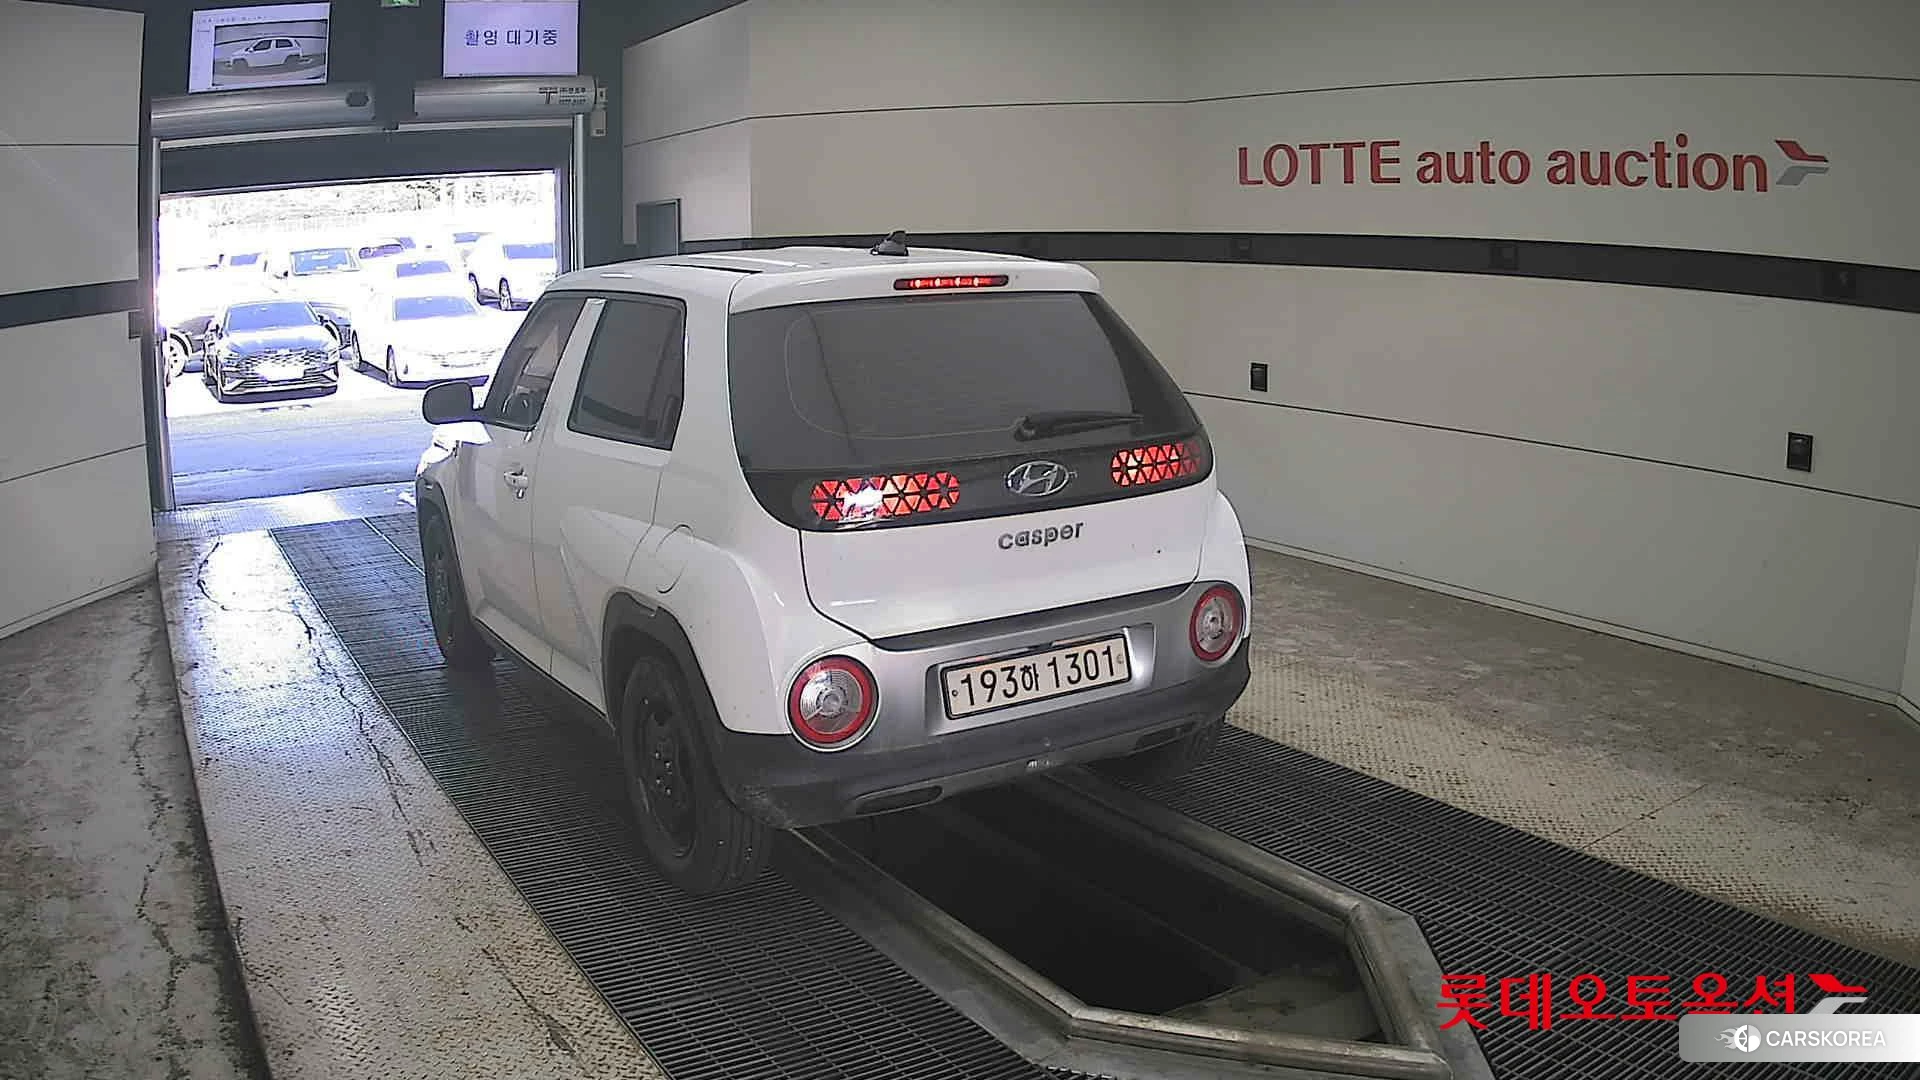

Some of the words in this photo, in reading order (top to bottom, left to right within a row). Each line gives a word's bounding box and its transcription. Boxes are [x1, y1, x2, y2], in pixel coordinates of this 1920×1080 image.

[506, 29, 557, 46] 대기중
[1238, 140, 1400, 187] LOTTE
[1416, 141, 1531, 185] auto
[1546, 133, 1768, 193] auction
[998, 522, 1084, 549] casper
[960, 663, 1040, 706] 193하
[1047, 645, 1114, 688] 1301
